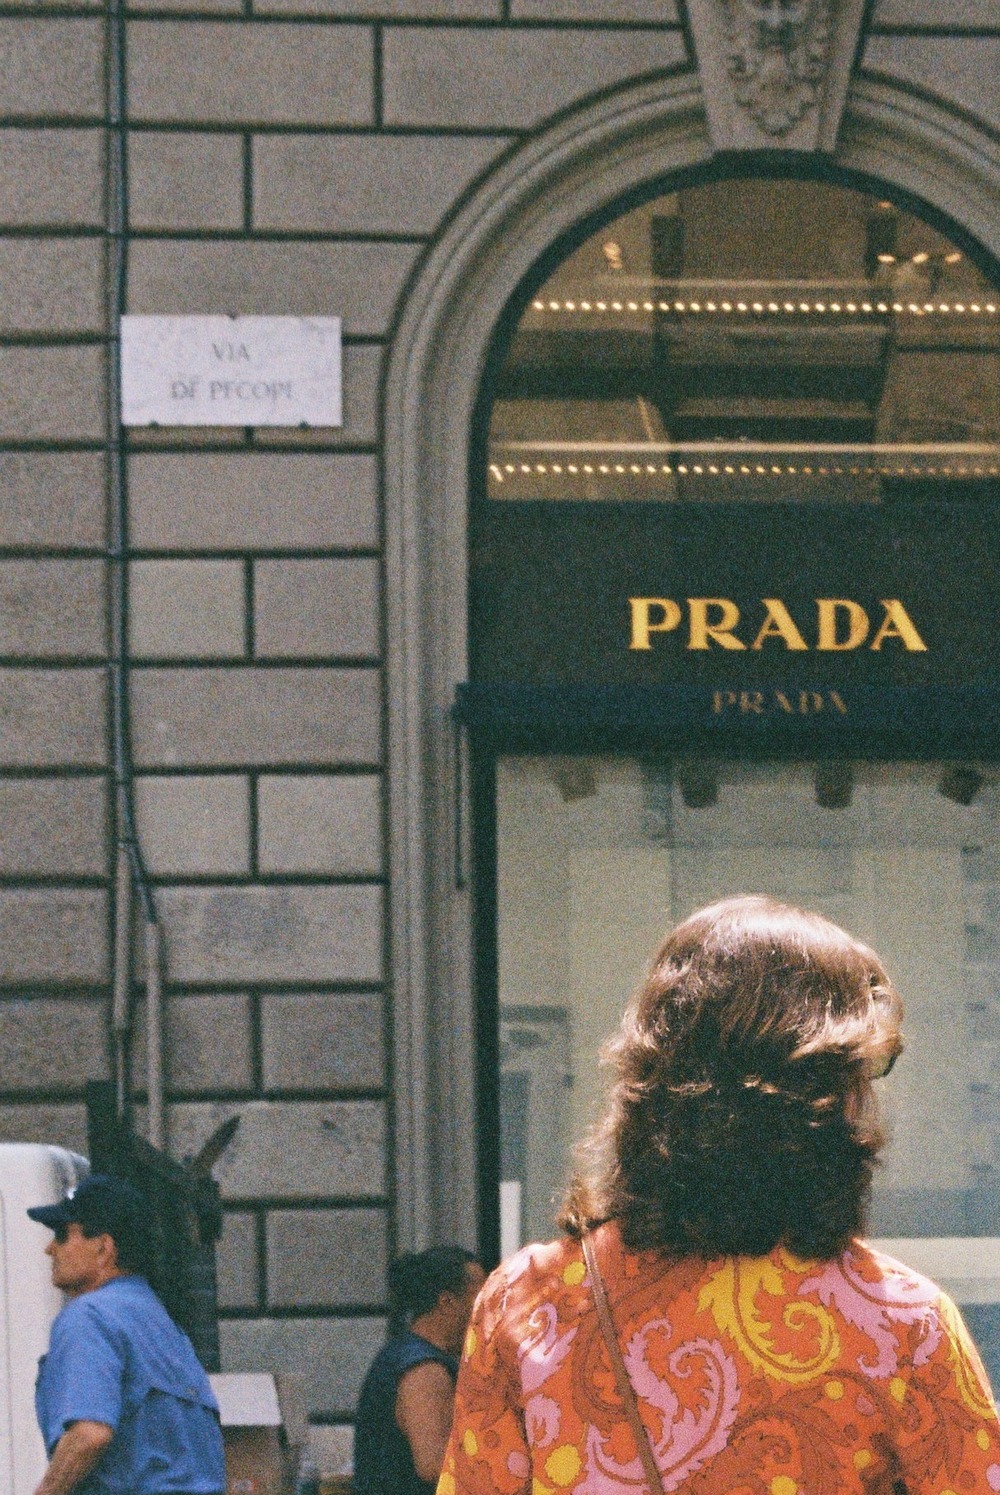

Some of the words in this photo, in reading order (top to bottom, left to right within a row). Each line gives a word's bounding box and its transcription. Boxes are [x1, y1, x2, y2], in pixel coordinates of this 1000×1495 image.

[211, 342, 250, 362] VIA
[628, 597, 928, 651] PRADA
[711, 690, 849, 714] PRADA
